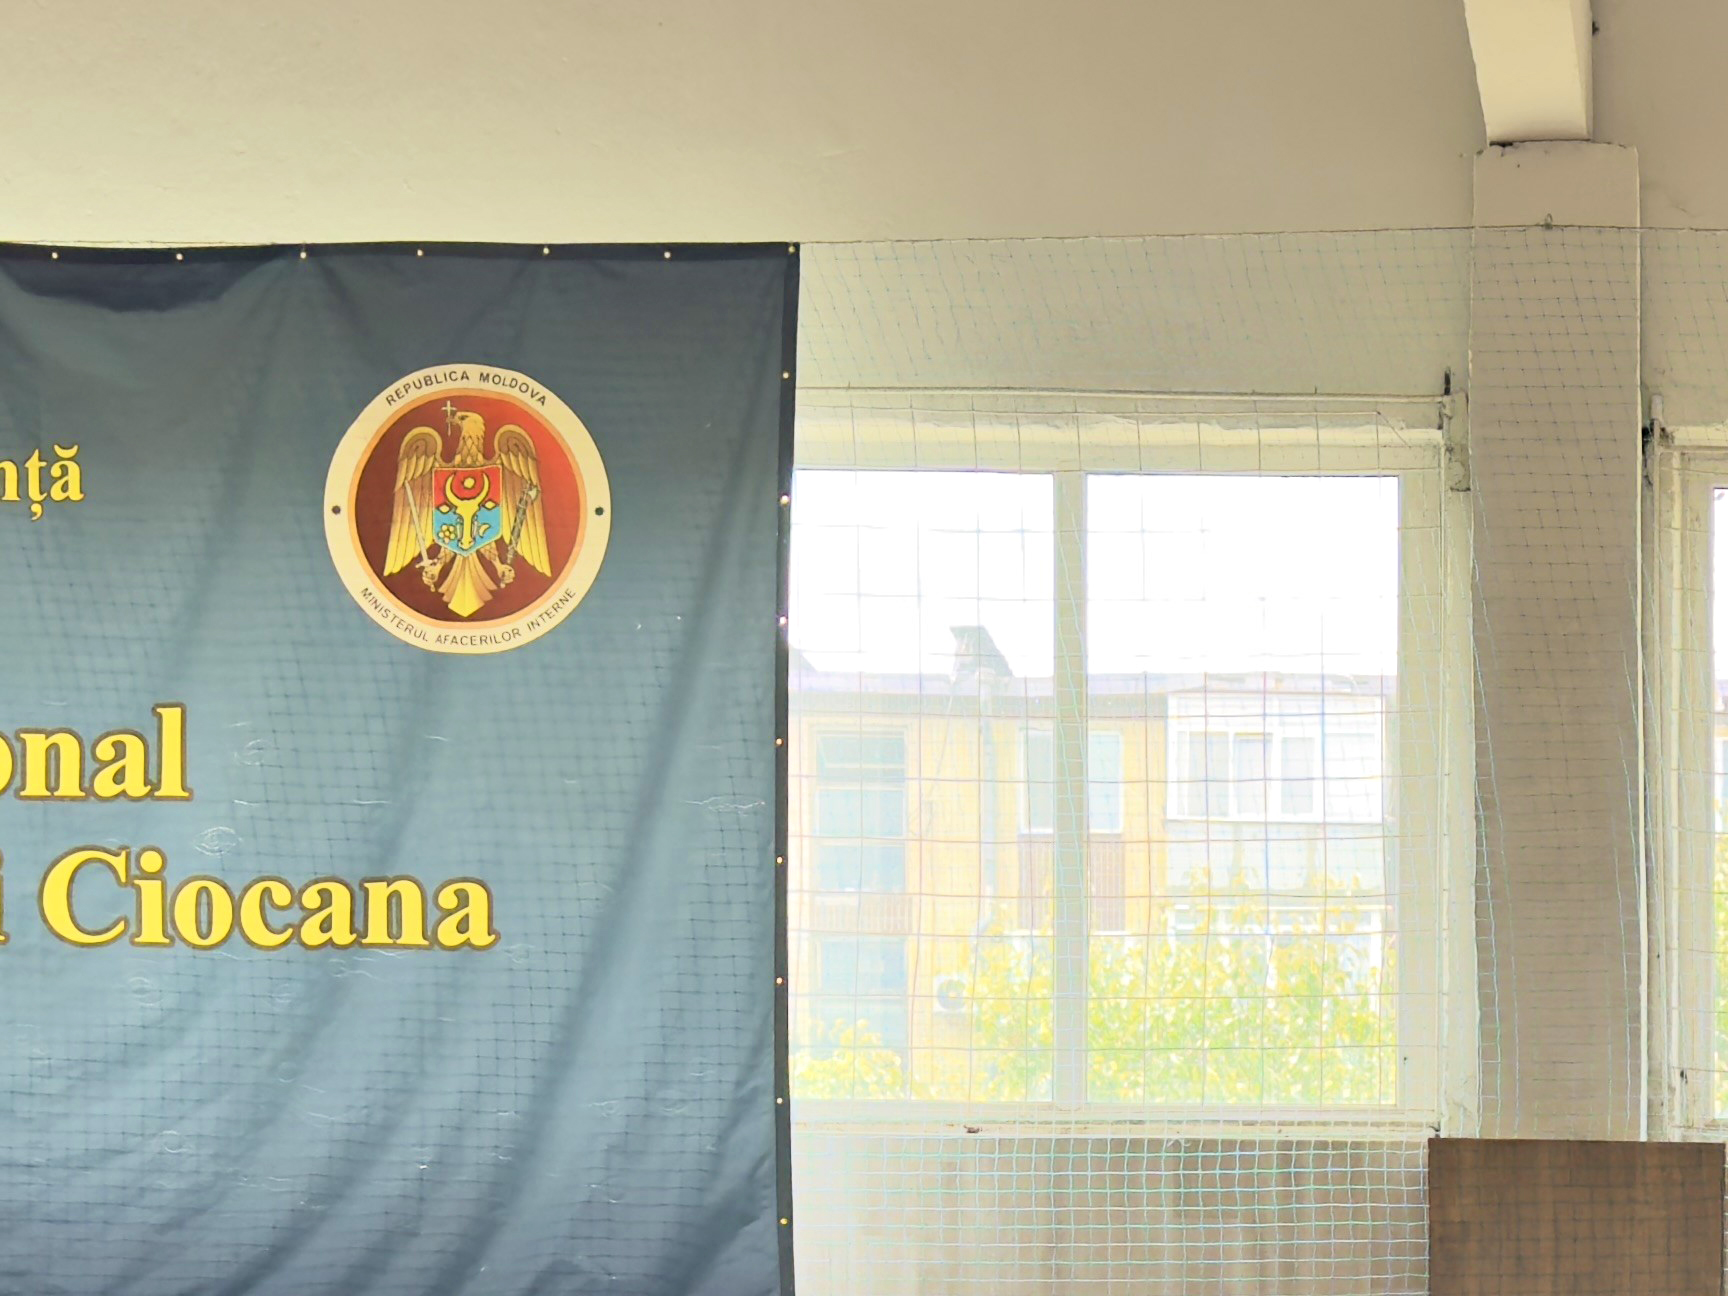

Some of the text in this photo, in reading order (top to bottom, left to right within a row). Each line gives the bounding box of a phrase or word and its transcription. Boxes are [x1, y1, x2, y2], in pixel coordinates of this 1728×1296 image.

[384, 370, 548, 407] REPUBLICA MOLDOVA
[360, 586, 576, 646] MINISTERUL AFACERILOR INTERNE
[38, 838, 501, 954] Ciocana
